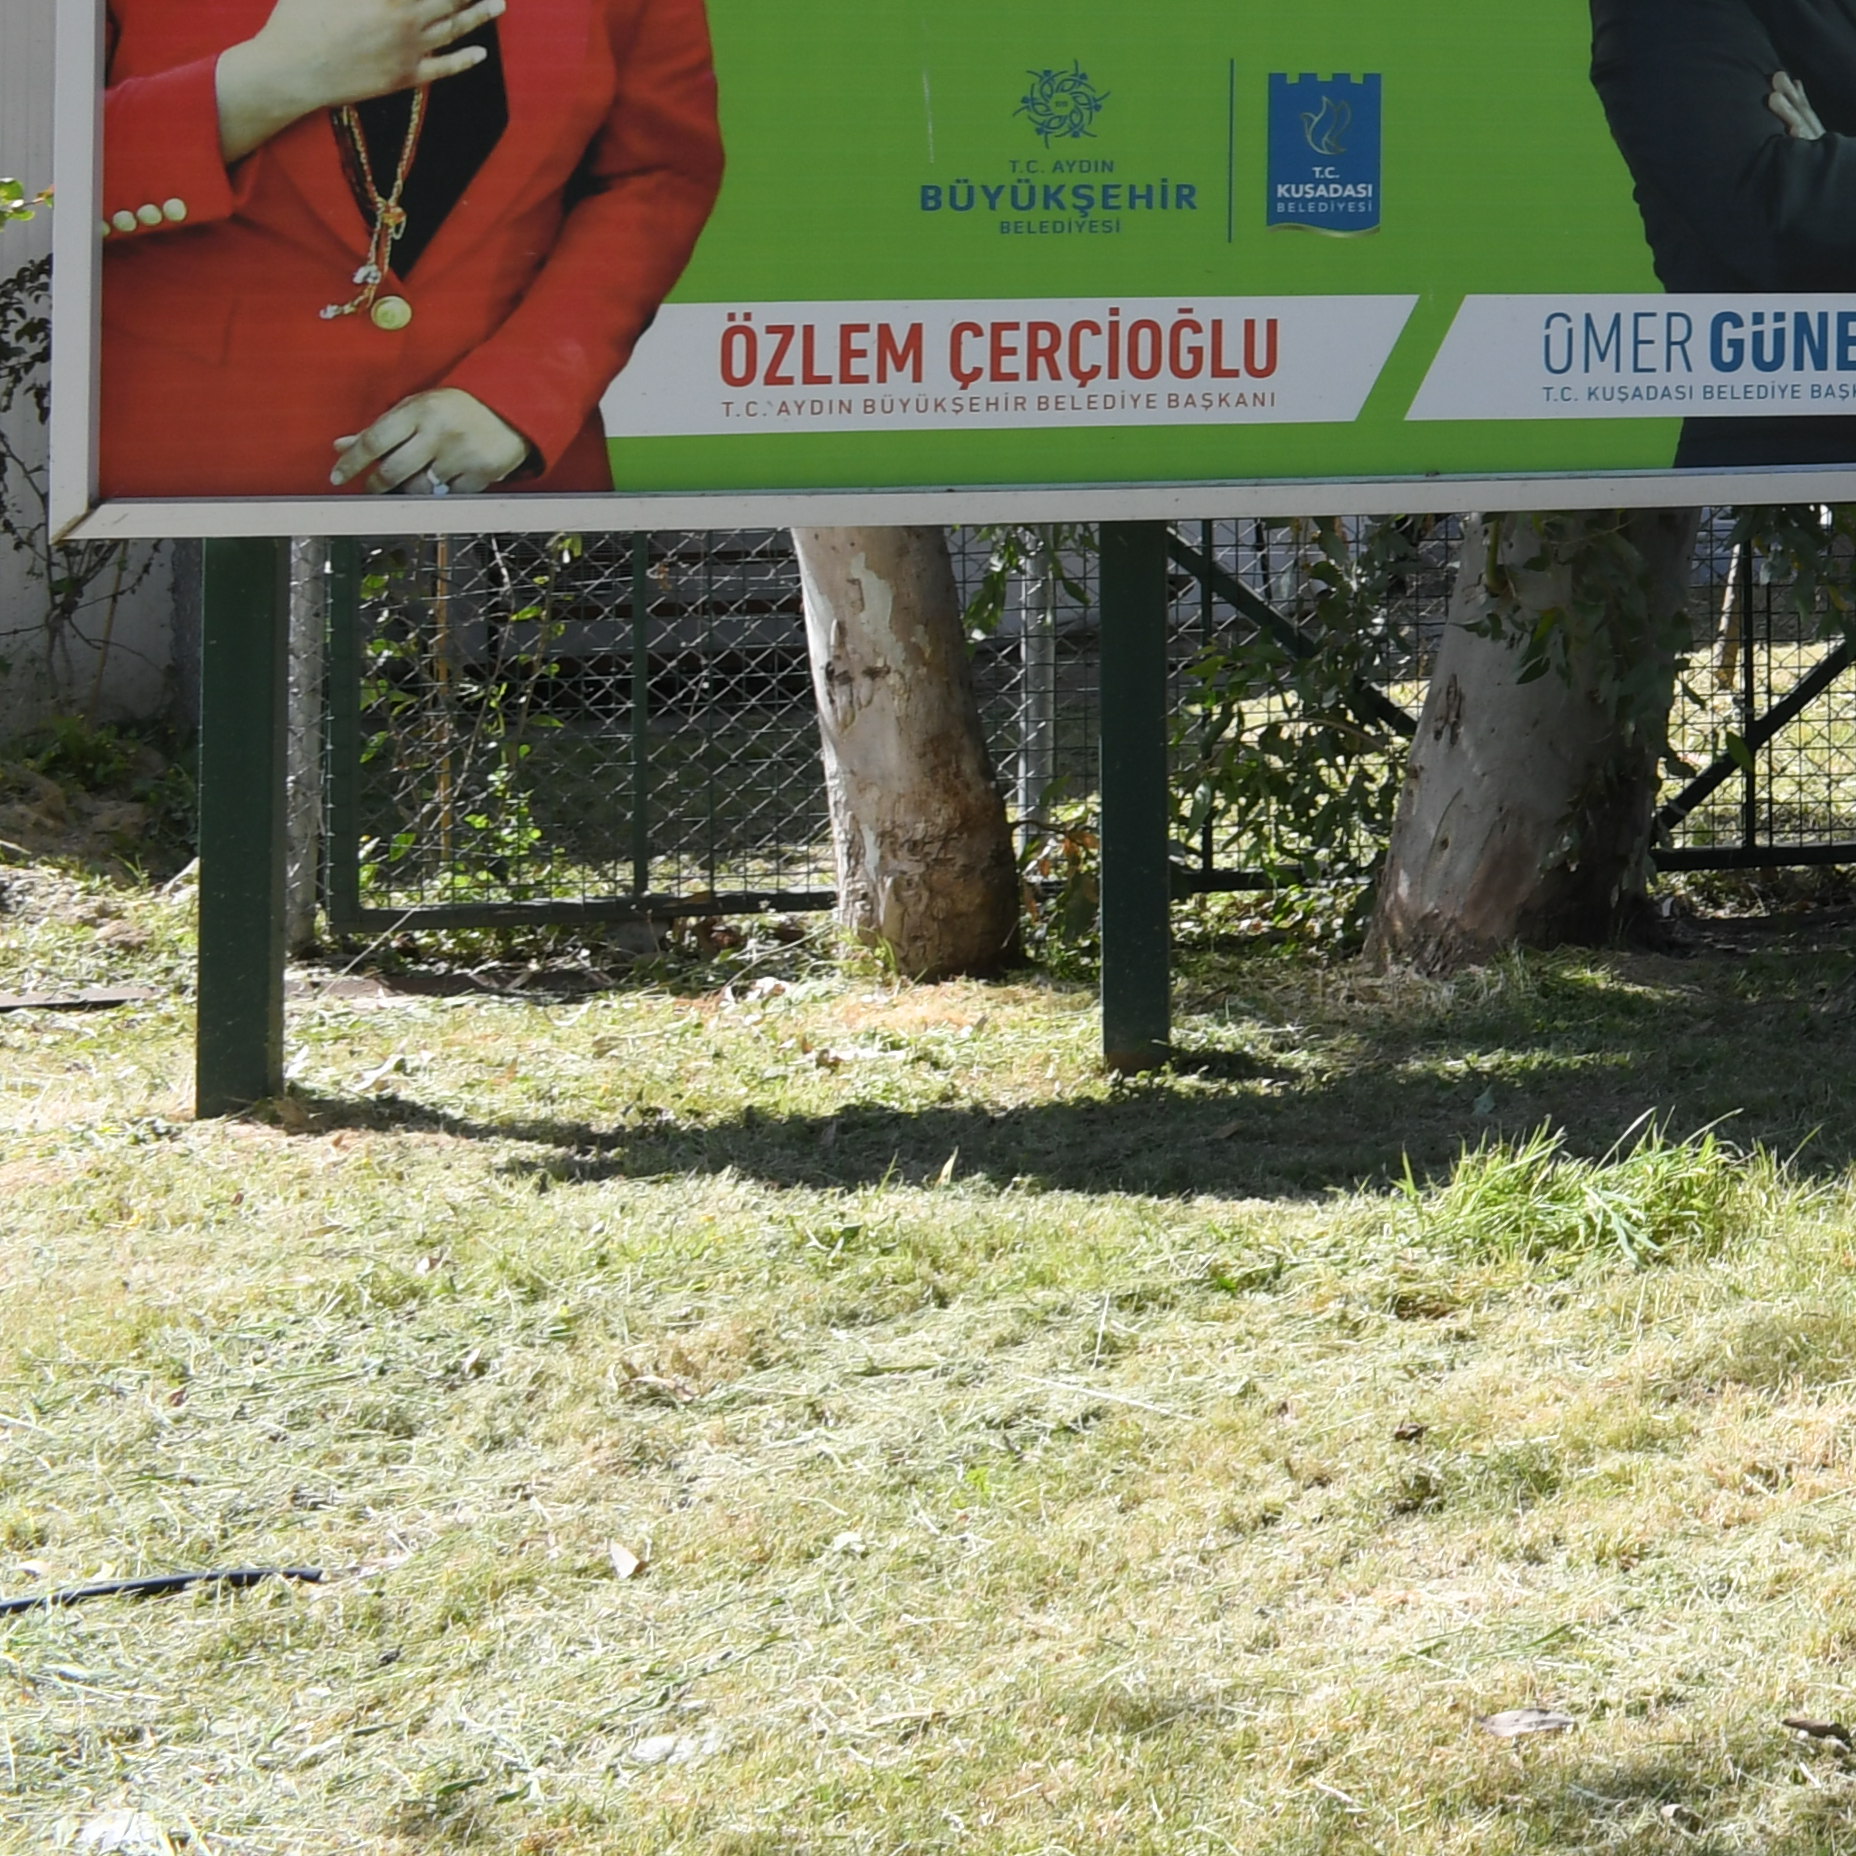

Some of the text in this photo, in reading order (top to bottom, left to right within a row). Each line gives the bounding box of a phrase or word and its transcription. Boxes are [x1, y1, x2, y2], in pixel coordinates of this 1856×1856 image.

[1010, 158, 1115, 175] T.C. AYDIN
[1312, 166, 1342, 180] T.C.
[919, 178, 1199, 219] BÜYÜKŞEHİR
[1276, 200, 1373, 213] BELEDİYESİ
[999, 215, 1122, 236] BELEDİYESİ
[720, 305, 1279, 391] ÖZLEM ÇERÇİOĞLU
[774, 398, 854, 417] AYDIN
[862, 391, 1028, 417] BÜYÜKŞEHİR
[1037, 389, 1158, 412] BELEDİYE
[1167, 390, 1278, 413] BAŞKANI
[1543, 386, 1579, 402] T.C.
[1587, 384, 1694, 404] KUŞADASI
[1702, 379, 1802, 400] BELEDİYE
